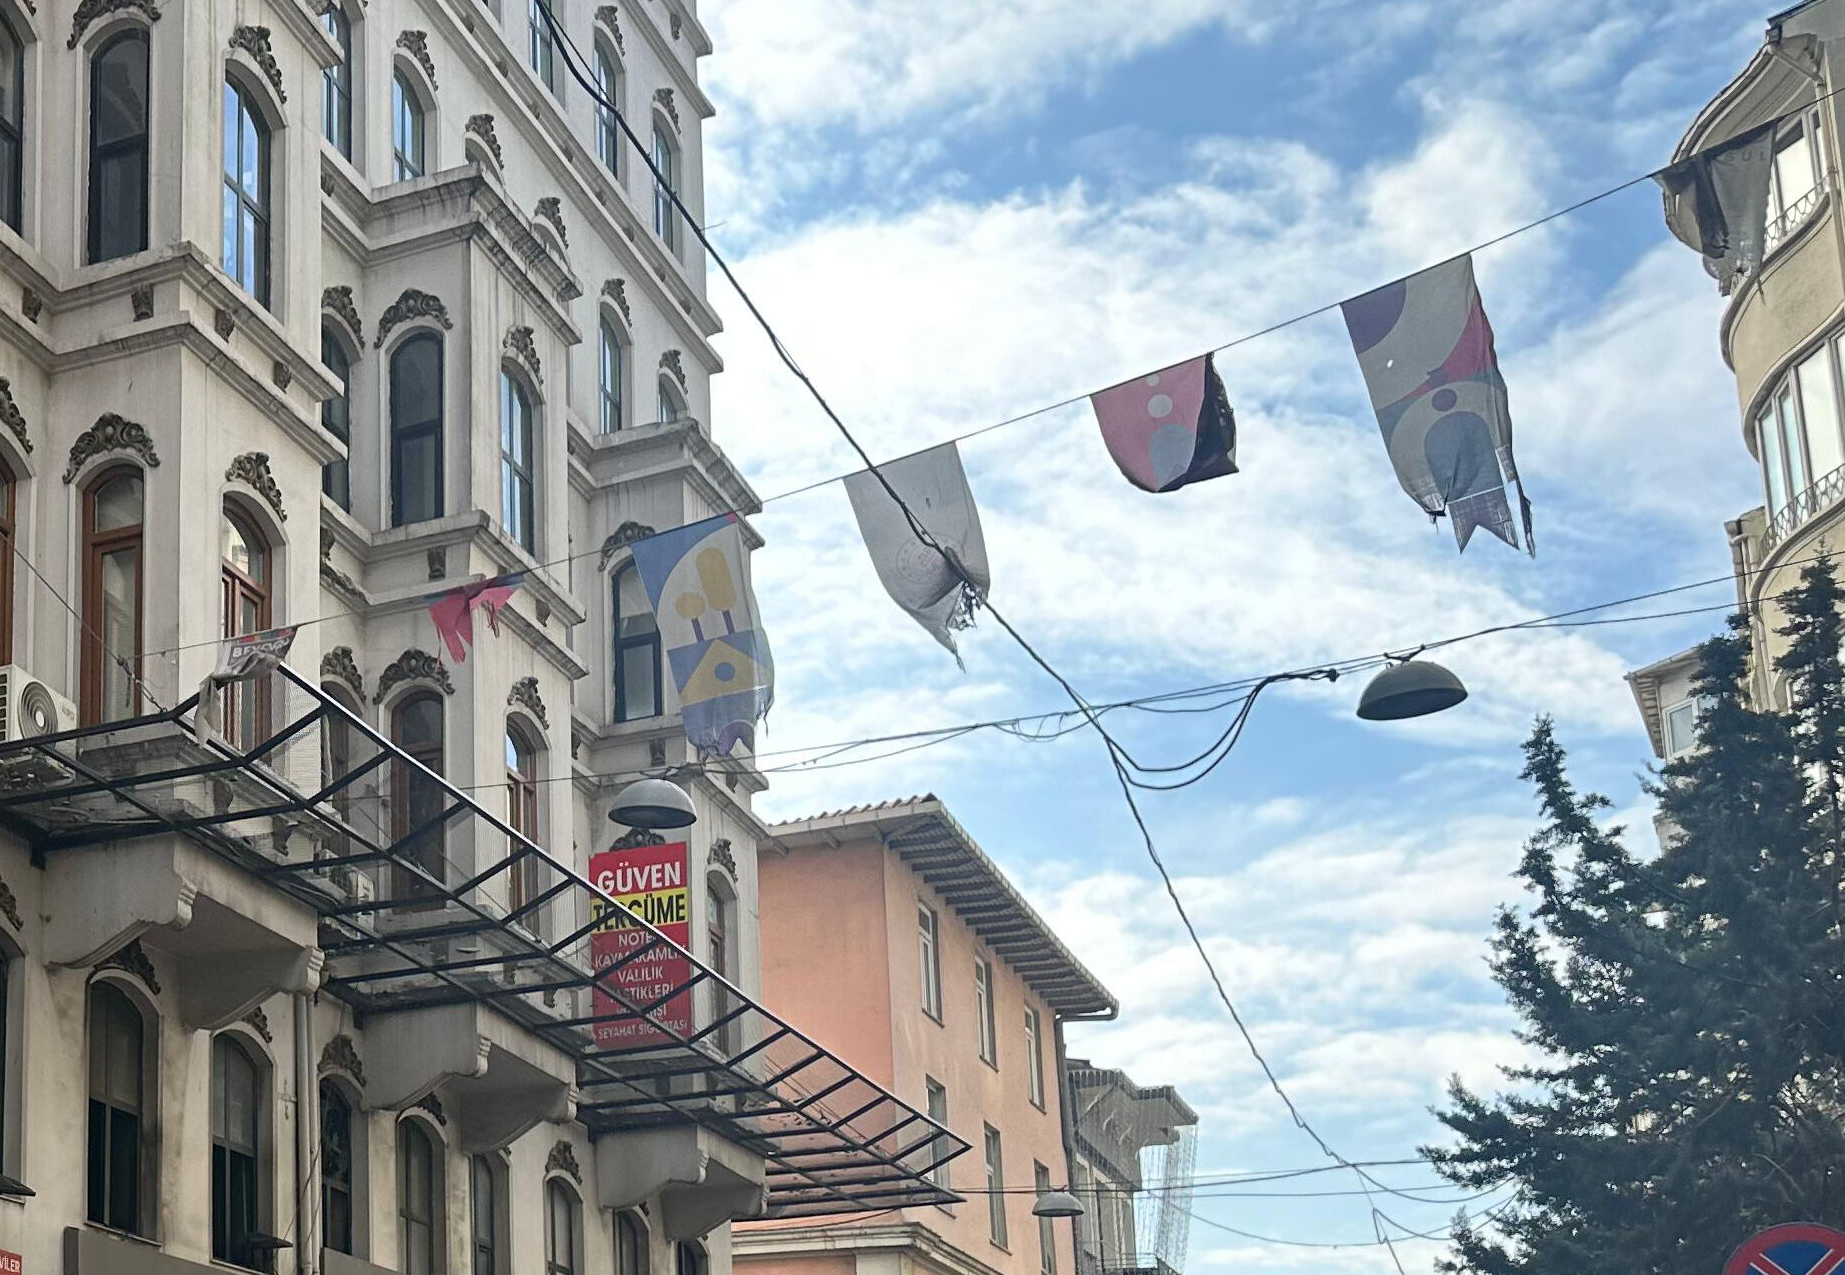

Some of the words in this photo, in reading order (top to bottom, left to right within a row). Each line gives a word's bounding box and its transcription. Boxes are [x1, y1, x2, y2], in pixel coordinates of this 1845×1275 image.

[597, 862, 681, 893] GÜVEN
[618, 931, 657, 947] NOTE
[598, 1024, 636, 1039] SEYAHAT
